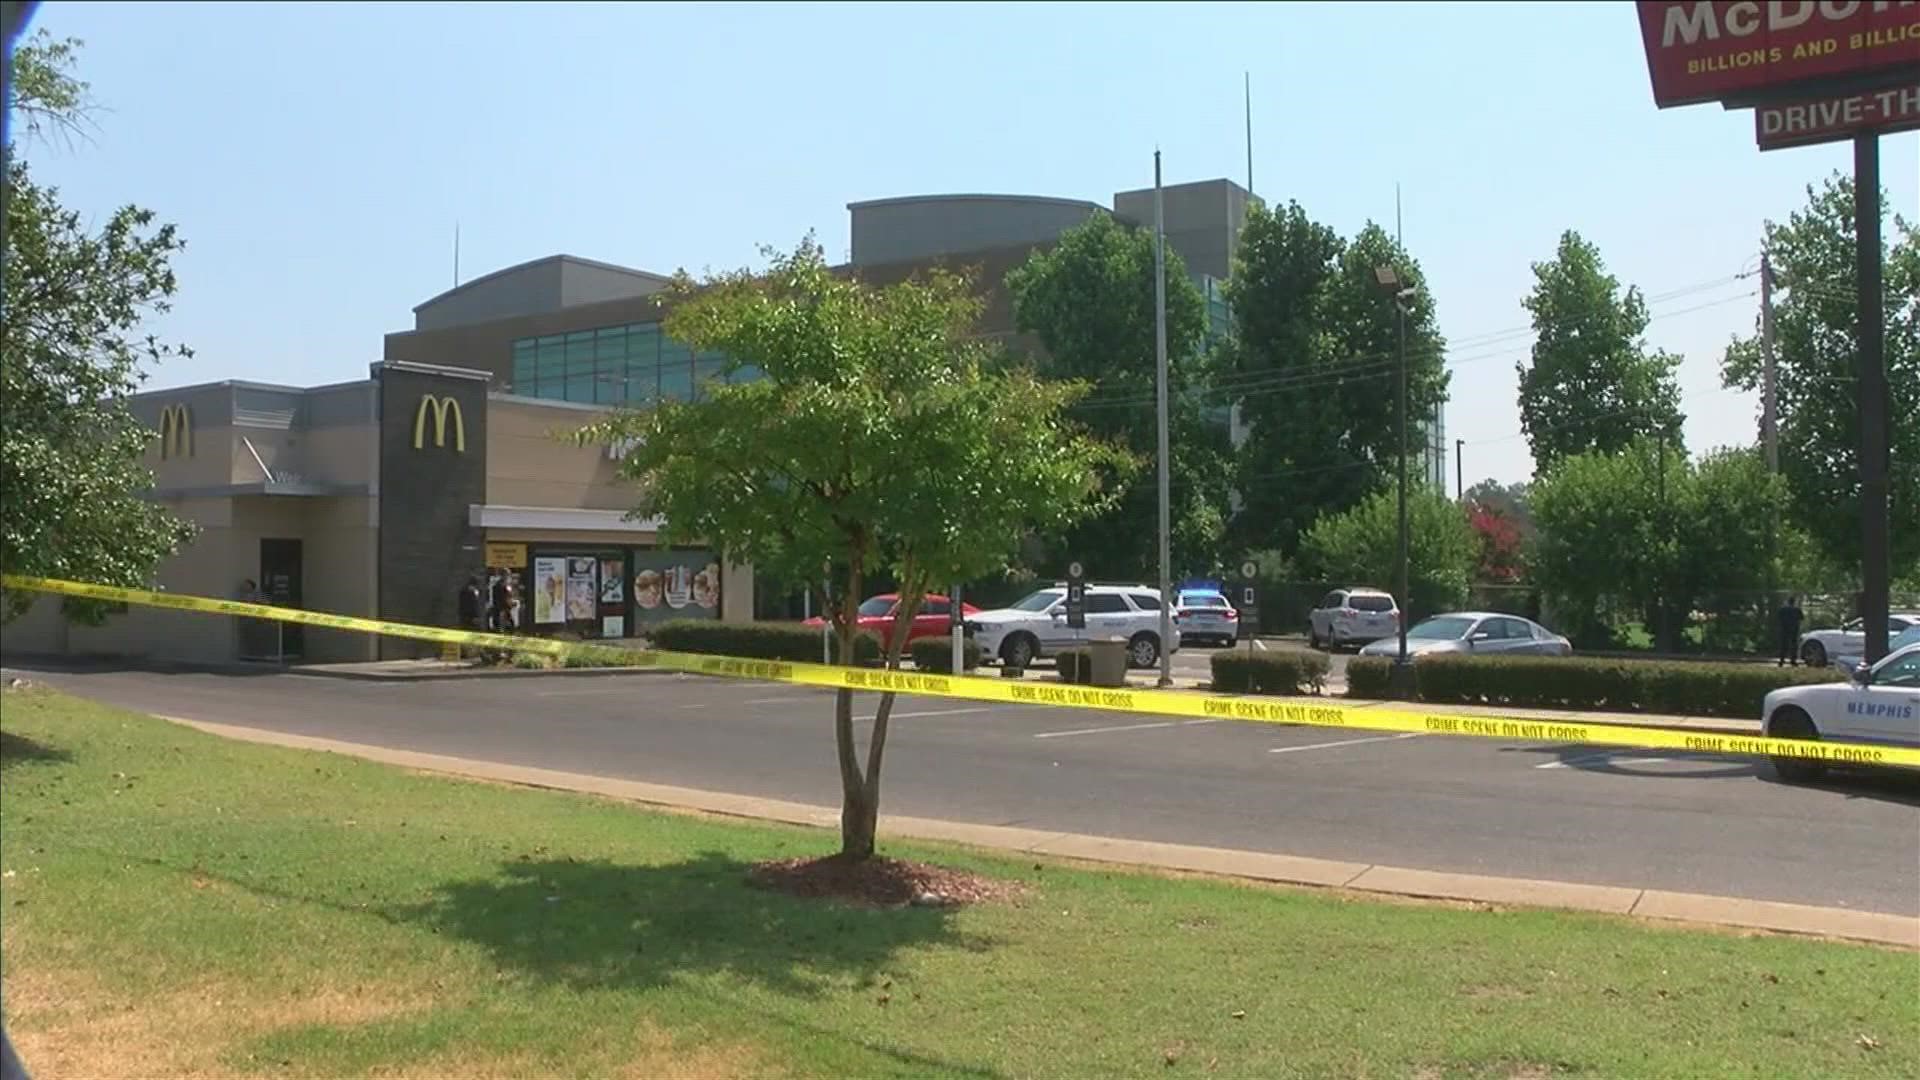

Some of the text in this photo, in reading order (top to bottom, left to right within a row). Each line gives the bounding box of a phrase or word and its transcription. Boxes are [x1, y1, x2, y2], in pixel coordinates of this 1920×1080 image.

[1662, 1, 1915, 48] McDo
[1687, 48, 1783, 74] BILLIONS
[1792, 38, 1838, 60] AND
[1762, 86, 1920, 134] DRIVE-TH
[1010, 684, 1134, 708] CRIME SCENE DO NOT CROSS
[1203, 698, 1345, 725] CRIME SCENE DO NOT CROSS
[1847, 701, 1913, 719] MEMPHIS
[1426, 716, 1588, 742] CRIME SCENE DO NOT CROSS
